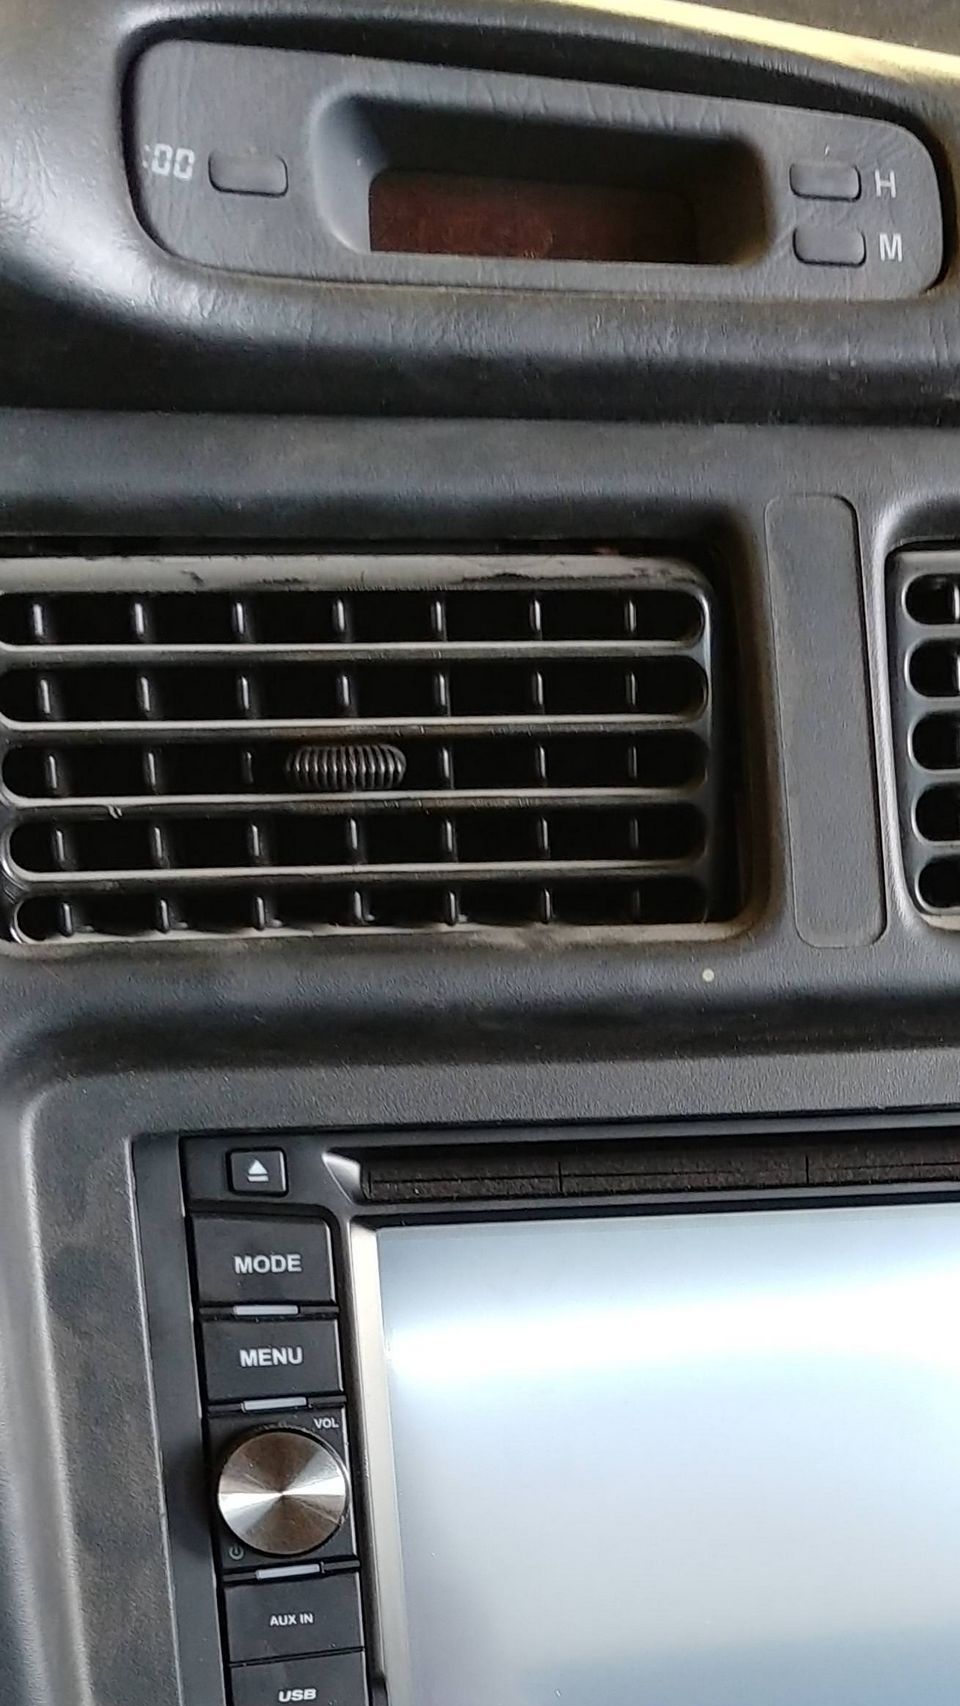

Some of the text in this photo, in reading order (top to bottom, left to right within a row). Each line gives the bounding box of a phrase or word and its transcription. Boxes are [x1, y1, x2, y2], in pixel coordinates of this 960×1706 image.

[875, 169, 896, 198] H
[880, 233, 902, 262] M
[234, 1254, 302, 1274] MODE
[239, 1347, 303, 1368] MENU
[313, 1417, 339, 1429] VOL
[270, 1612, 314, 1626] AUX IN
[278, 1688, 317, 1702] USB
